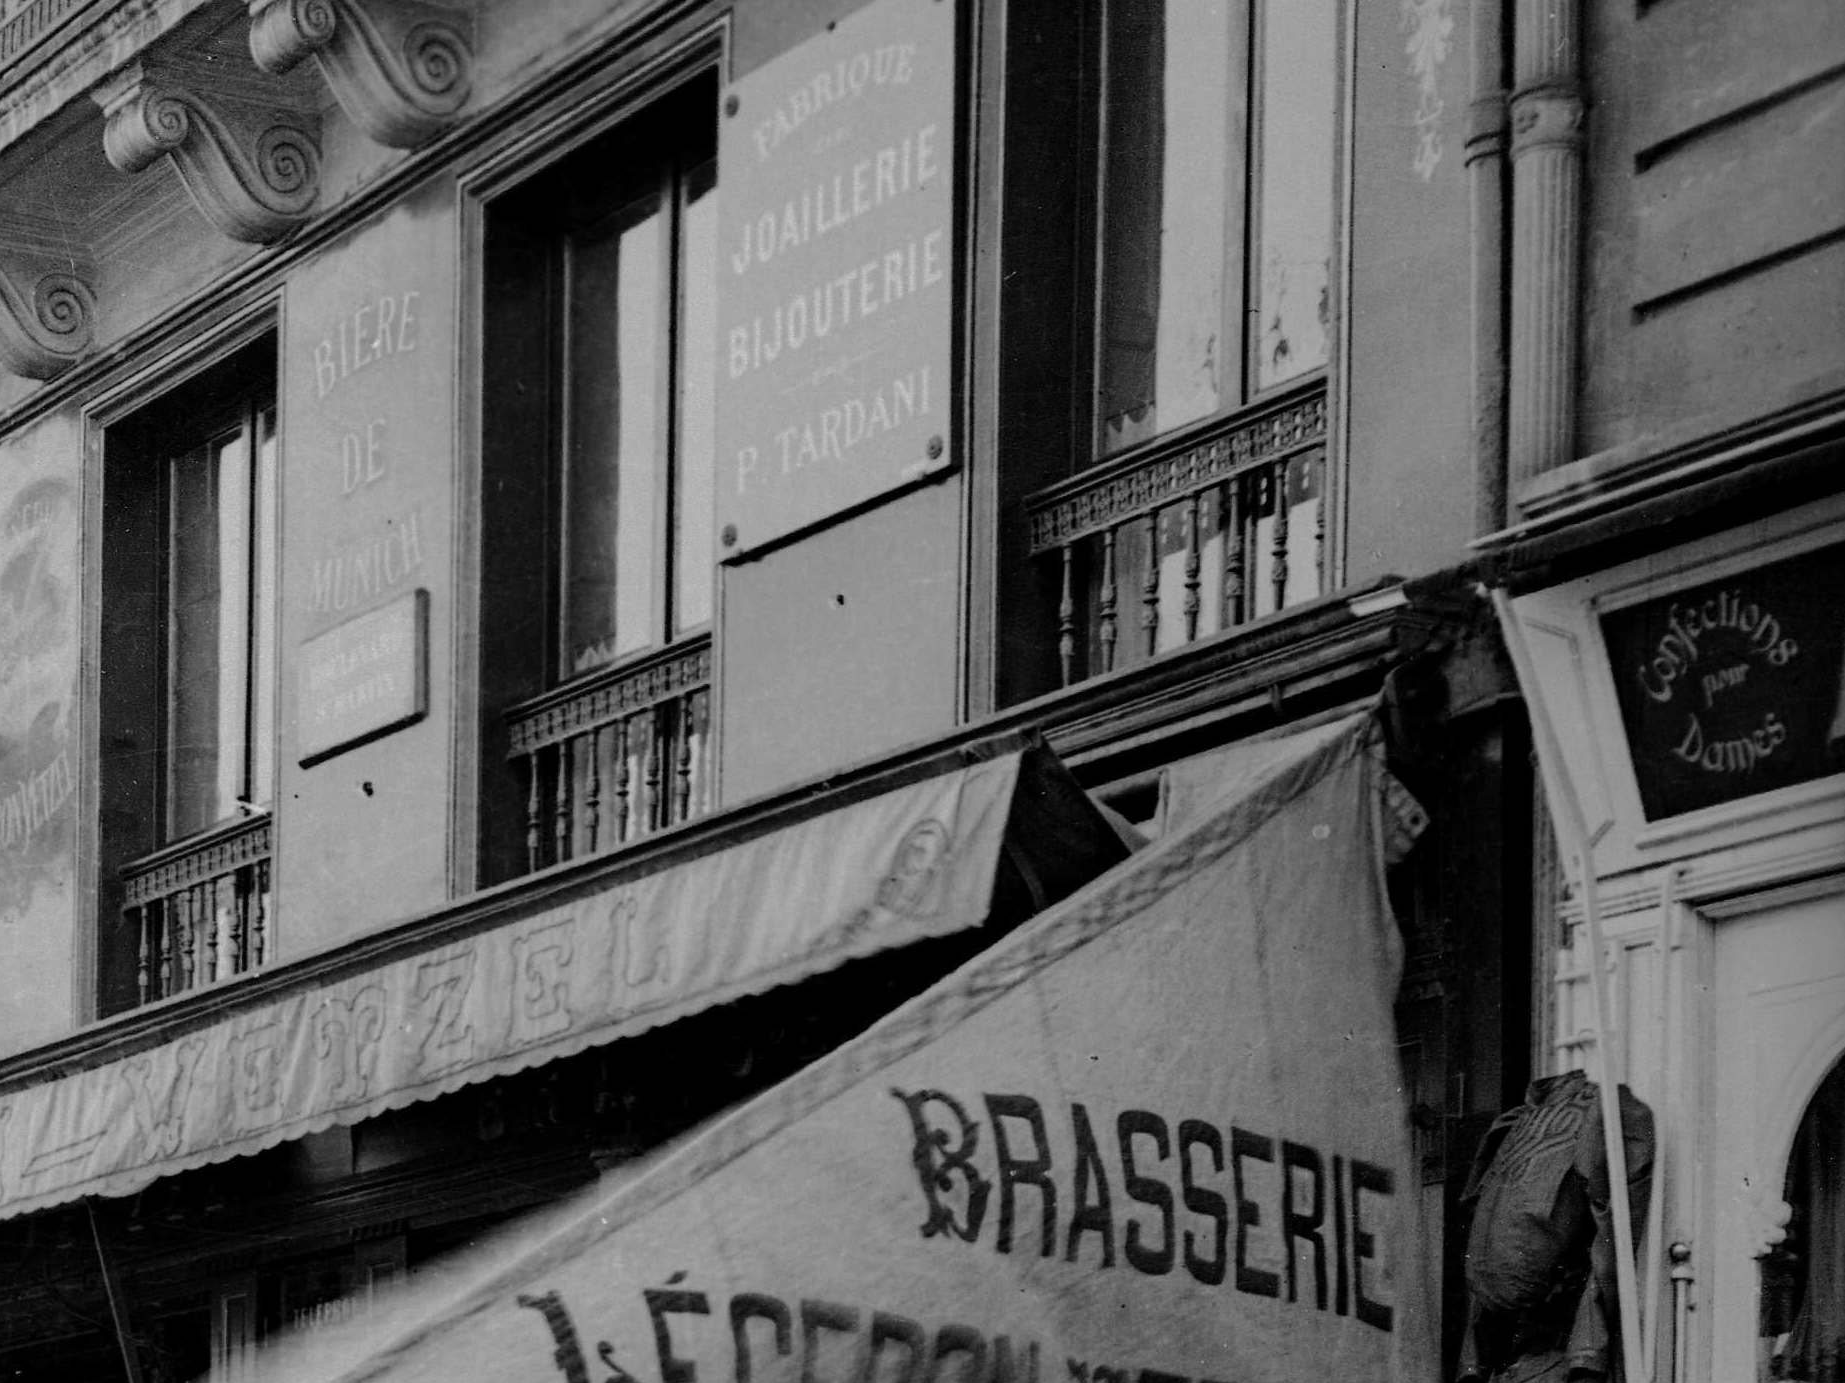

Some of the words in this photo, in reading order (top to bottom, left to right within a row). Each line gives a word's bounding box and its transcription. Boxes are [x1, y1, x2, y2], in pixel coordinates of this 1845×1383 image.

[753, 42, 916, 161] FABRIQUE
[732, 124, 938, 275] JOAILLERIE
[726, 228, 944, 379] BIJOUTERIE
[340, 420, 387, 495] DE
[776, 366, 932, 477] TARDANI
[1700, 662, 1752, 709] pour
[888, 1084, 1396, 1333] BRASSERIE
